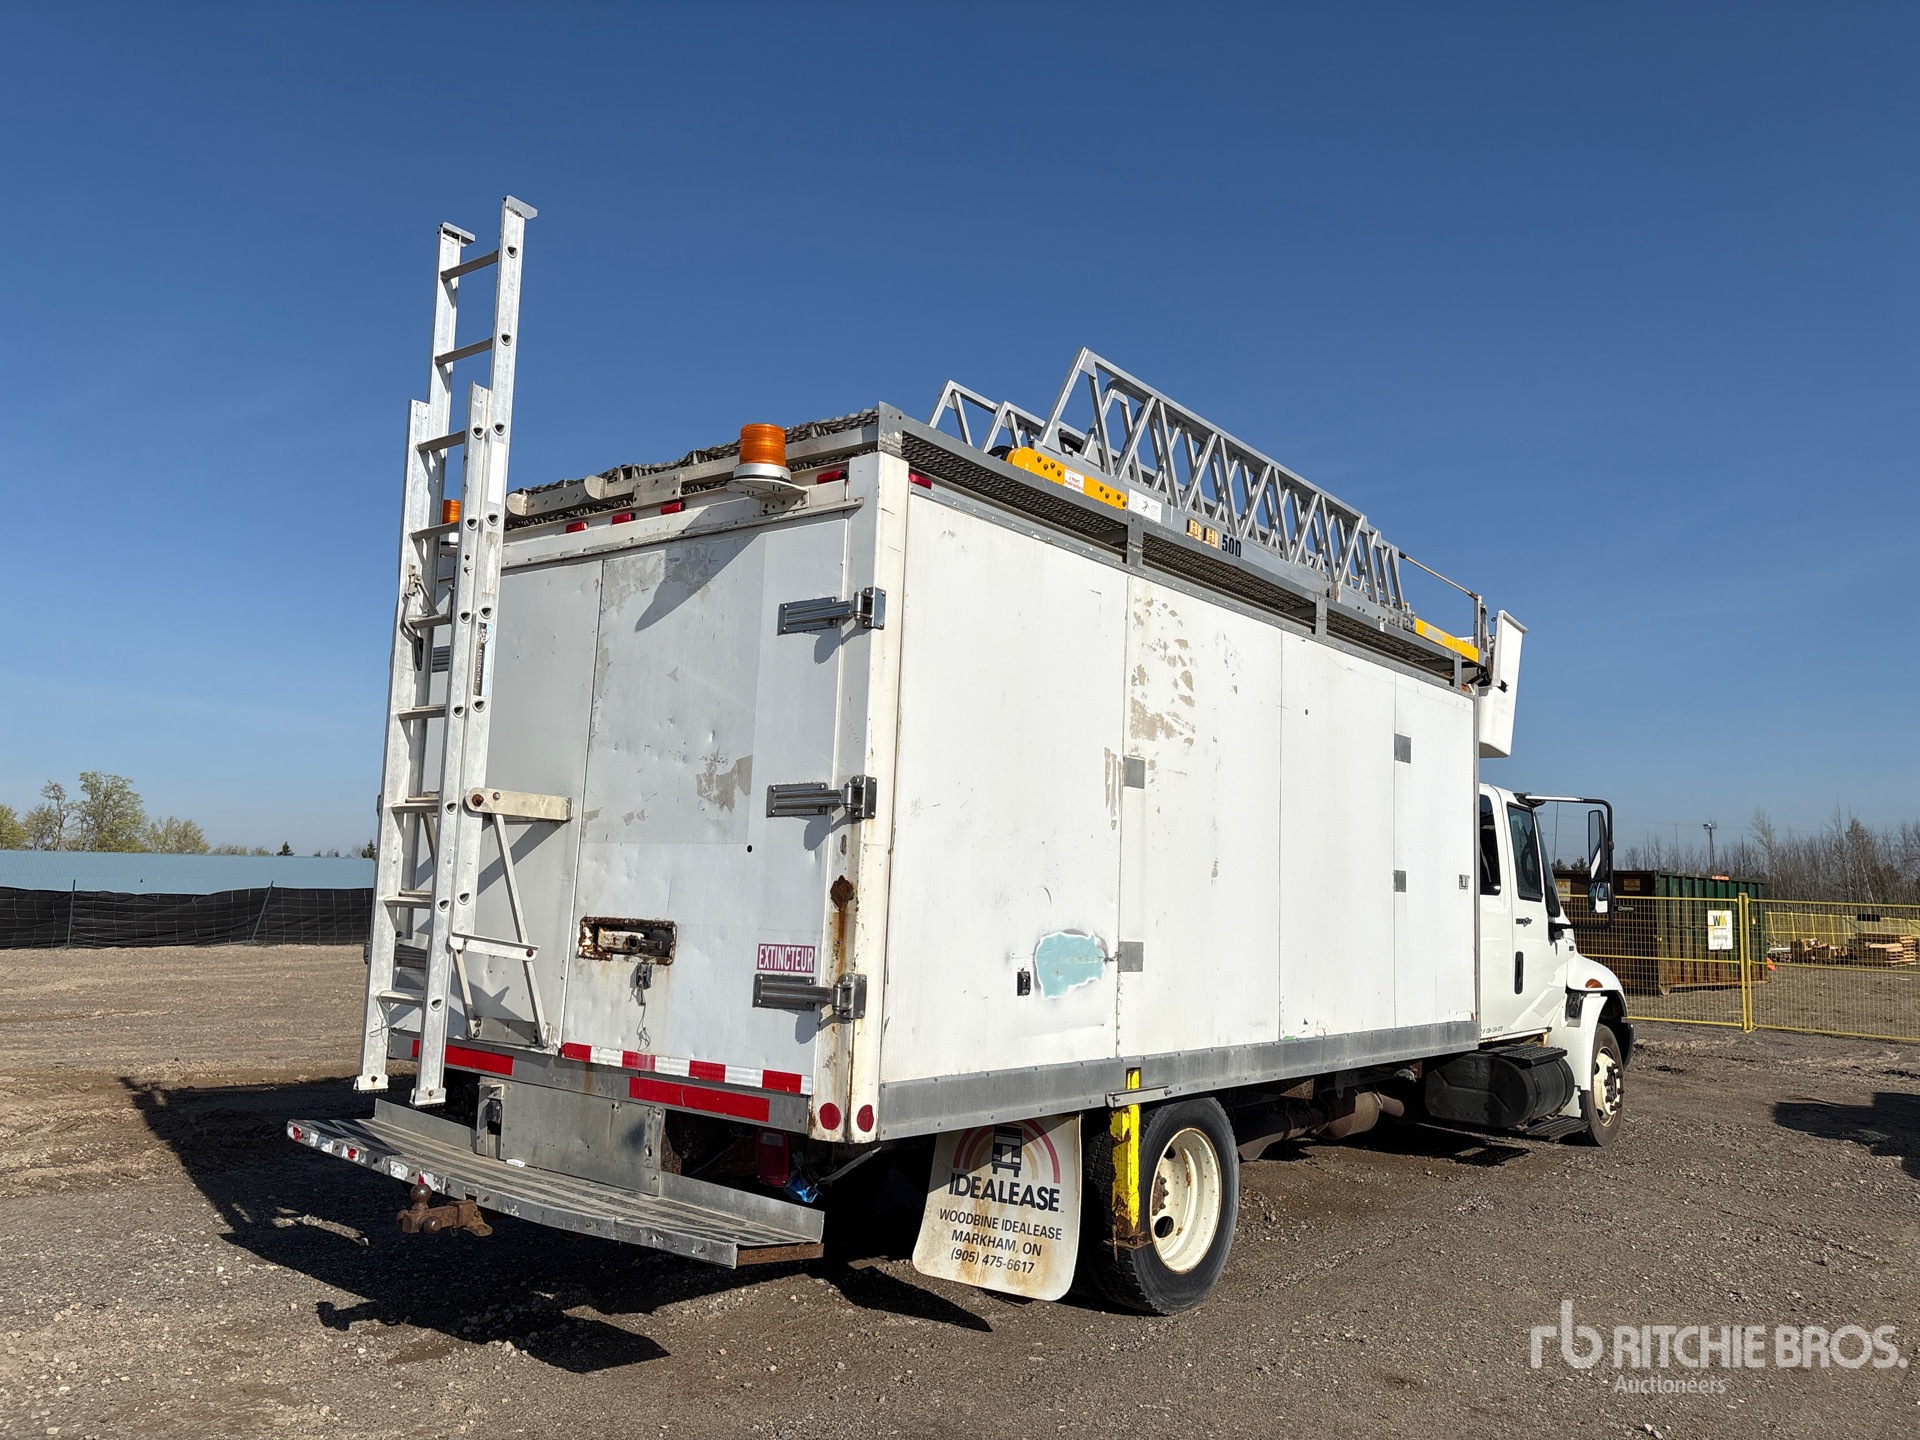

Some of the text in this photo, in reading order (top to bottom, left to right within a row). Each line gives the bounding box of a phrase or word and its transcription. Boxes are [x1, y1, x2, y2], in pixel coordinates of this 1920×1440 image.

[758, 945, 814, 972] EXTINCTEUR
[948, 1172, 1061, 1212] IDEALEASE
[939, 1208, 1062, 1241] WOODBINE IDEALEASE
[951, 1229, 1042, 1257] MARKHAM, ON
[951, 1247, 1035, 1274] (905) 475-6617
